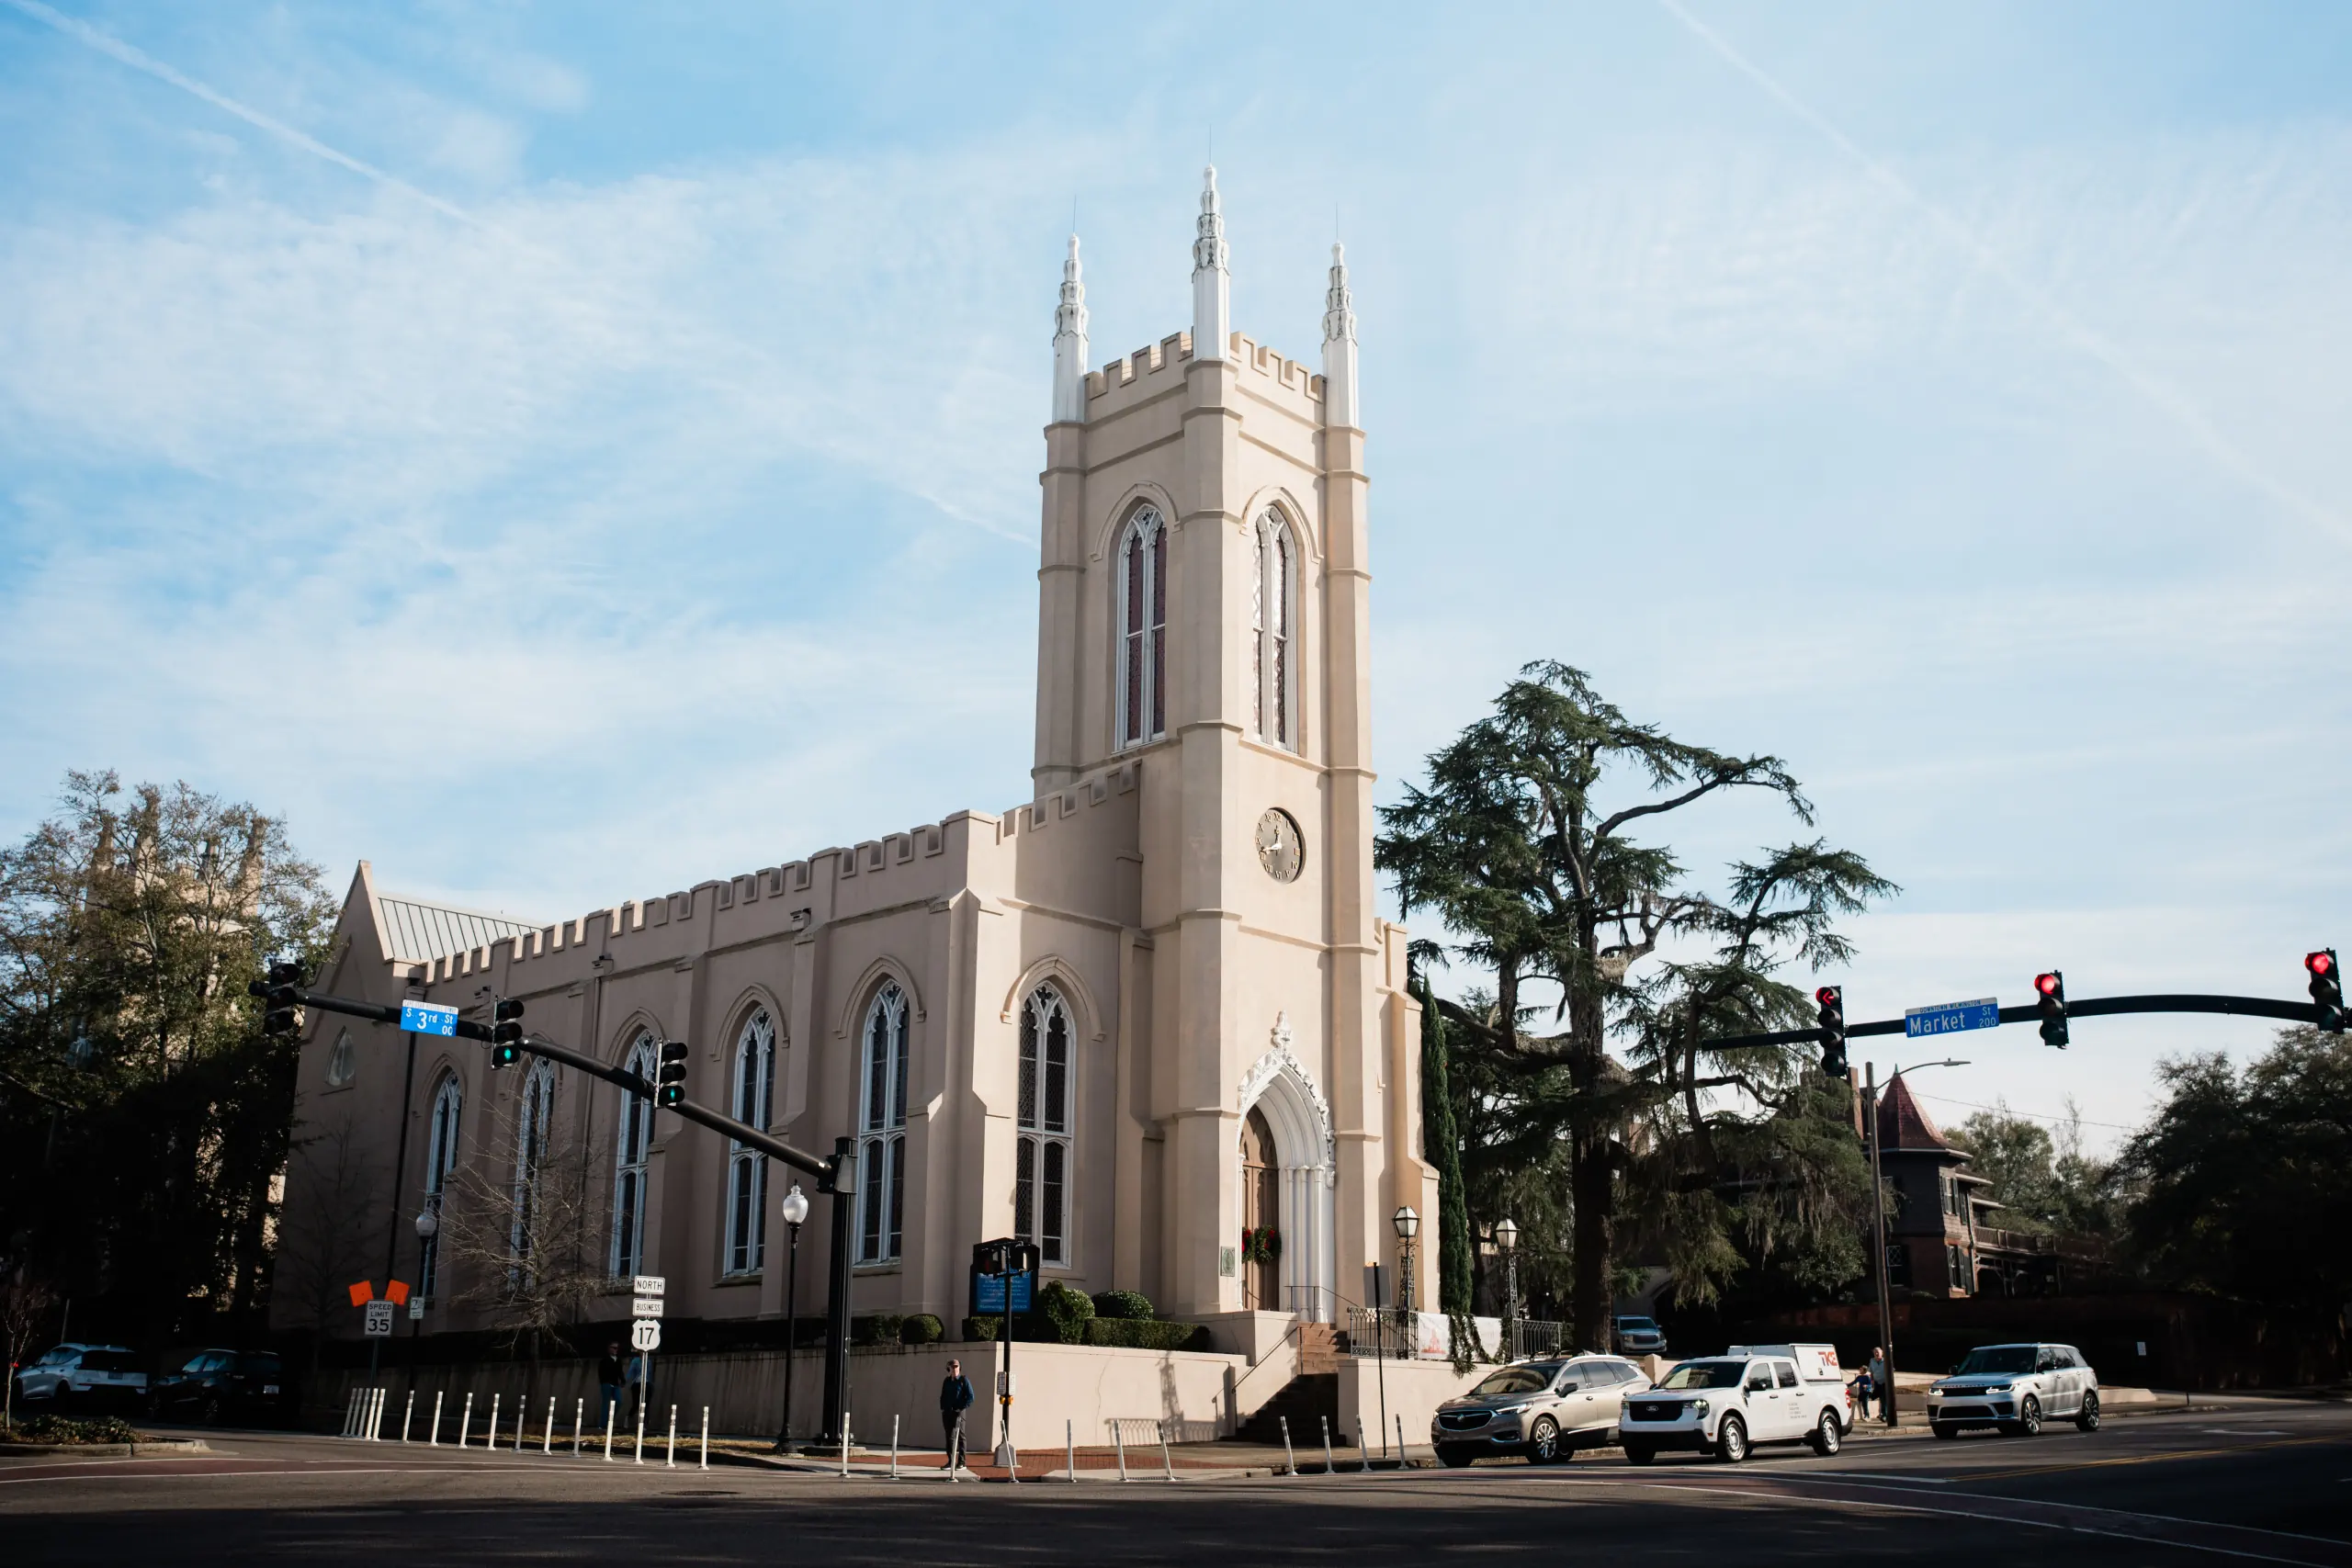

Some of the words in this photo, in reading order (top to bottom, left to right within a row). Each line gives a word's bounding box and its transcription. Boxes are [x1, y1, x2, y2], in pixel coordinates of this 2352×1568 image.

[1920, 1005, 1948, 1013] DOWNTOWN
[1950, 999, 1982, 1009] WILMINGTON
[417, 1011, 438, 1030] 3rd
[445, 1014, 454, 1024] St
[1910, 1011, 1966, 1035] Market
[1983, 1007, 1992, 1016] St
[1979, 1017, 1996, 1028] 200
[442, 1026, 453, 1035] 00
[637, 1280, 662, 1291] NORTH
[636, 1303, 662, 1312] BUSINESS
[368, 1319, 390, 1332] 35
[639, 1326, 655, 1345] 17
